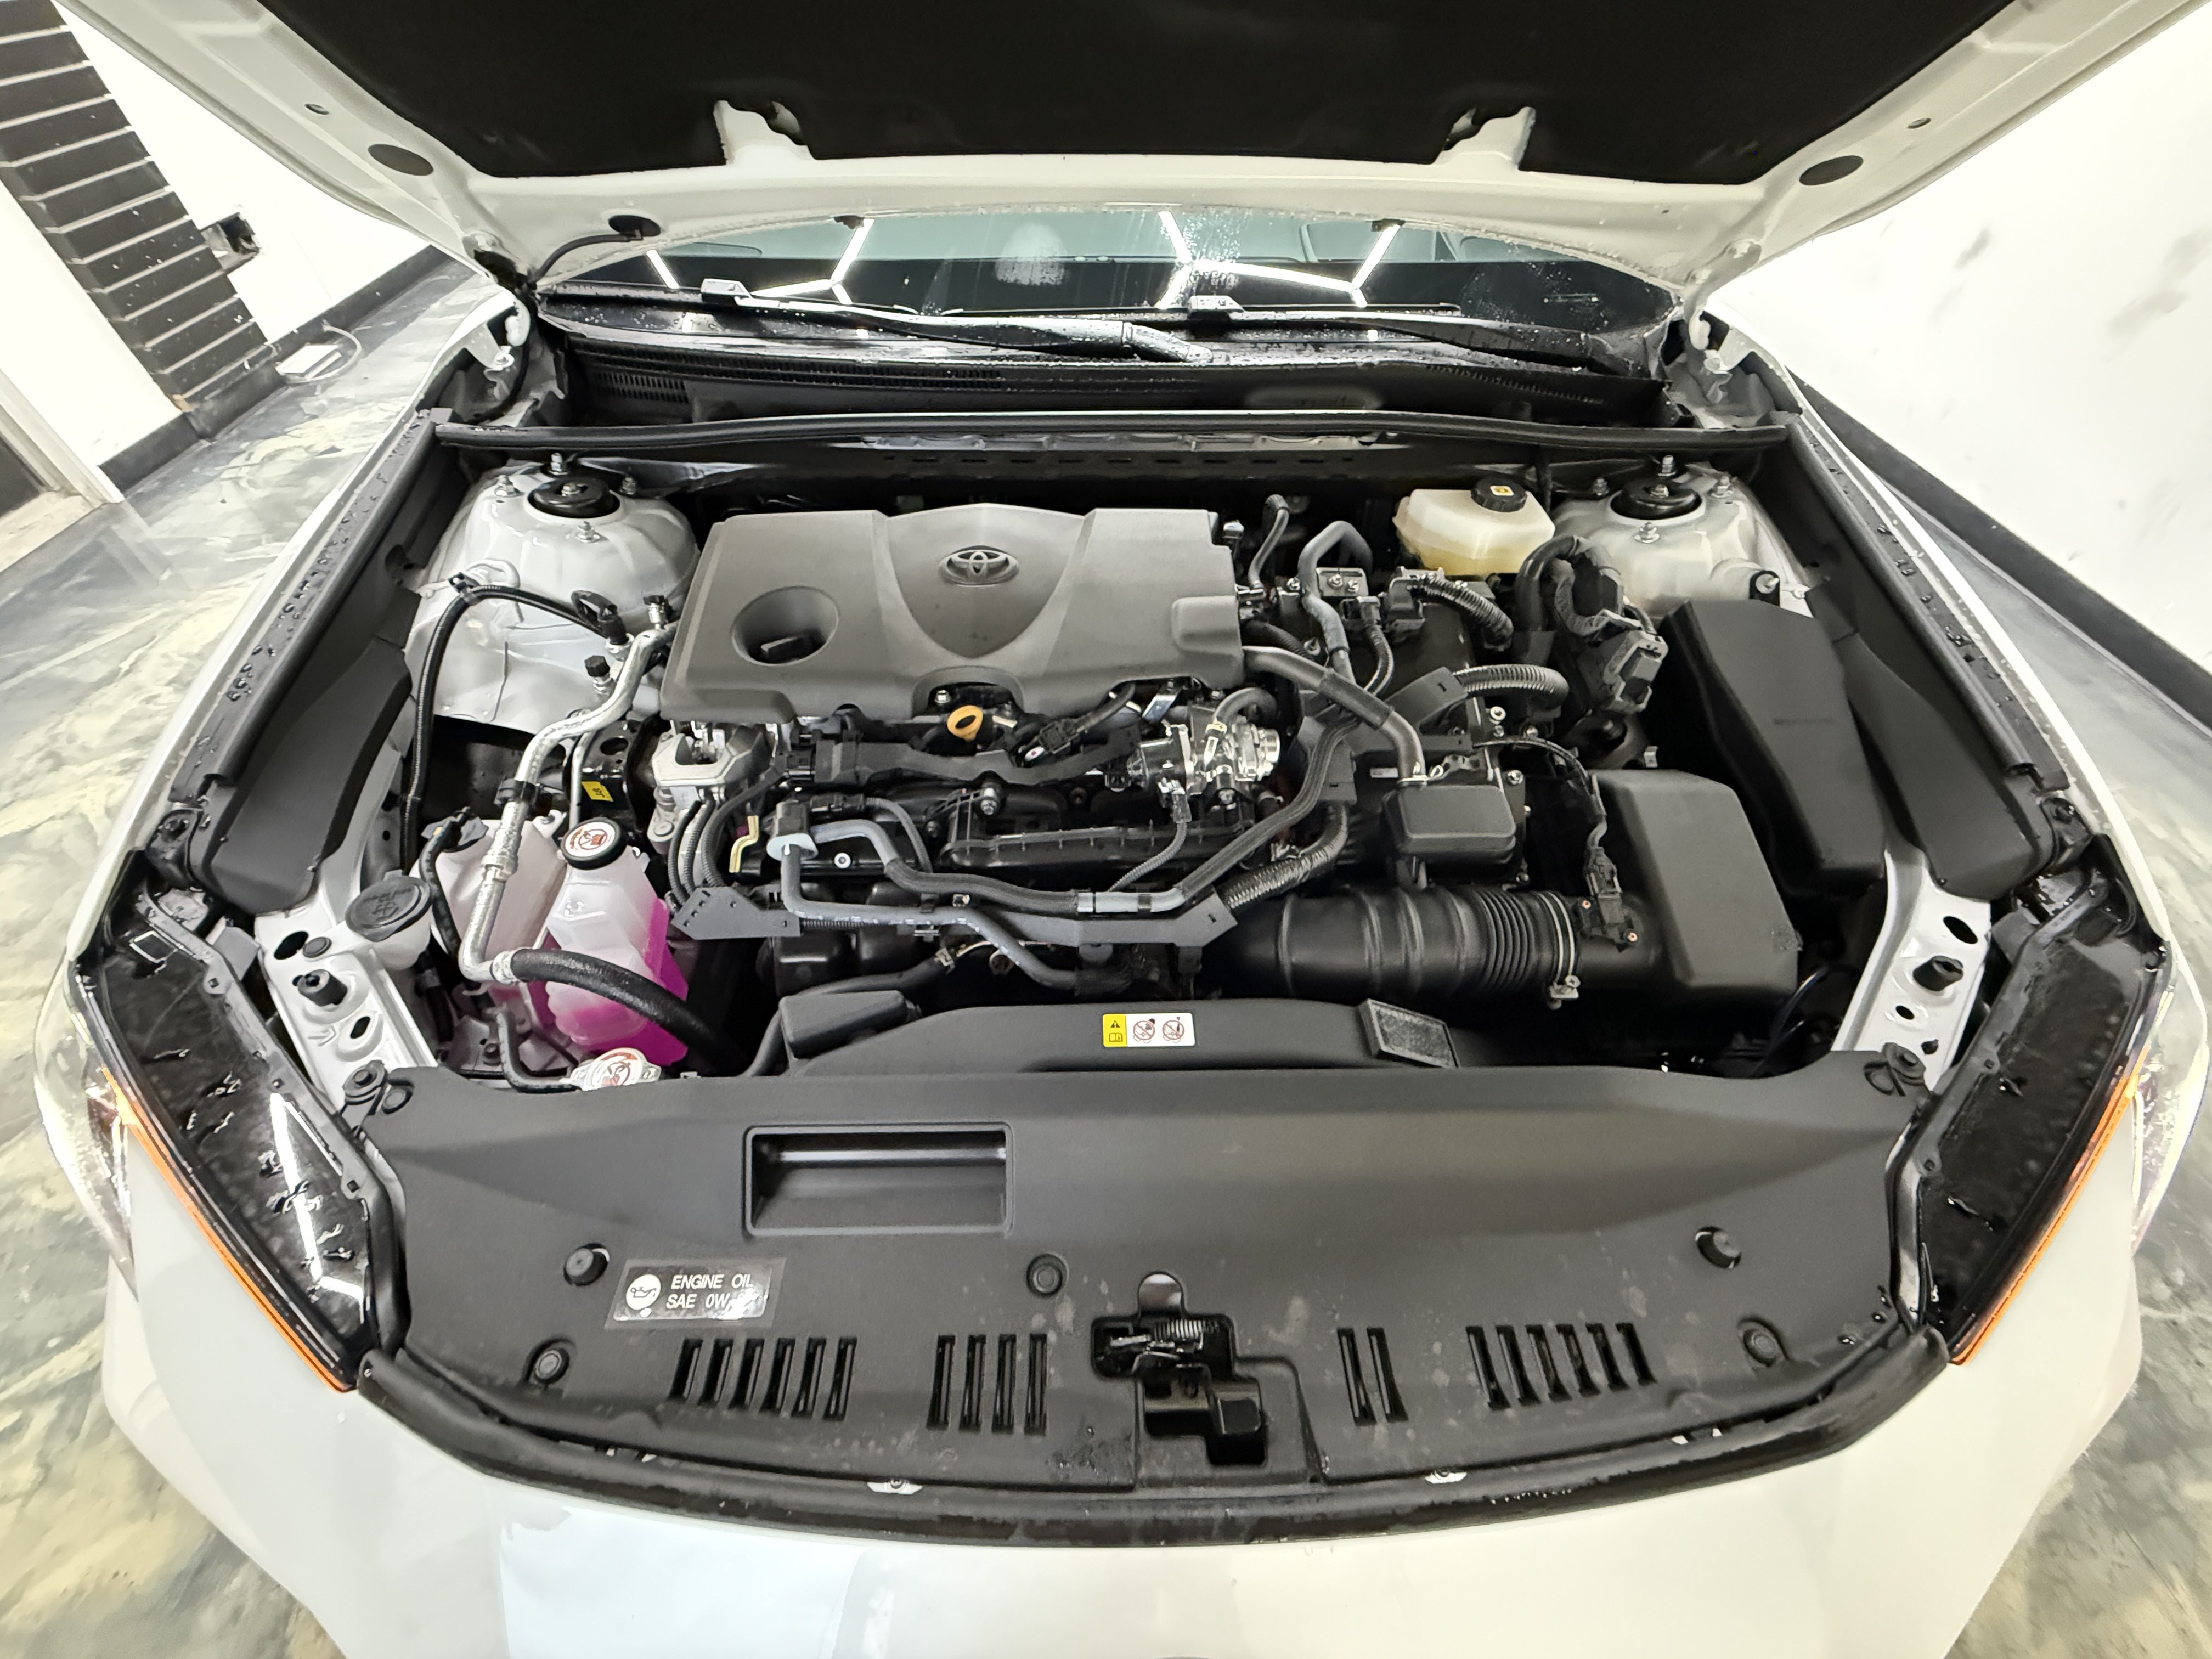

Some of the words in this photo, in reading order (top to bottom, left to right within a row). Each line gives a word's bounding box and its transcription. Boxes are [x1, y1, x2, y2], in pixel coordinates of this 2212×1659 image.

[670, 1274, 725, 1289] ENGINE
[731, 1273, 754, 1289] OIL
[666, 1293, 697, 1309] SAE
